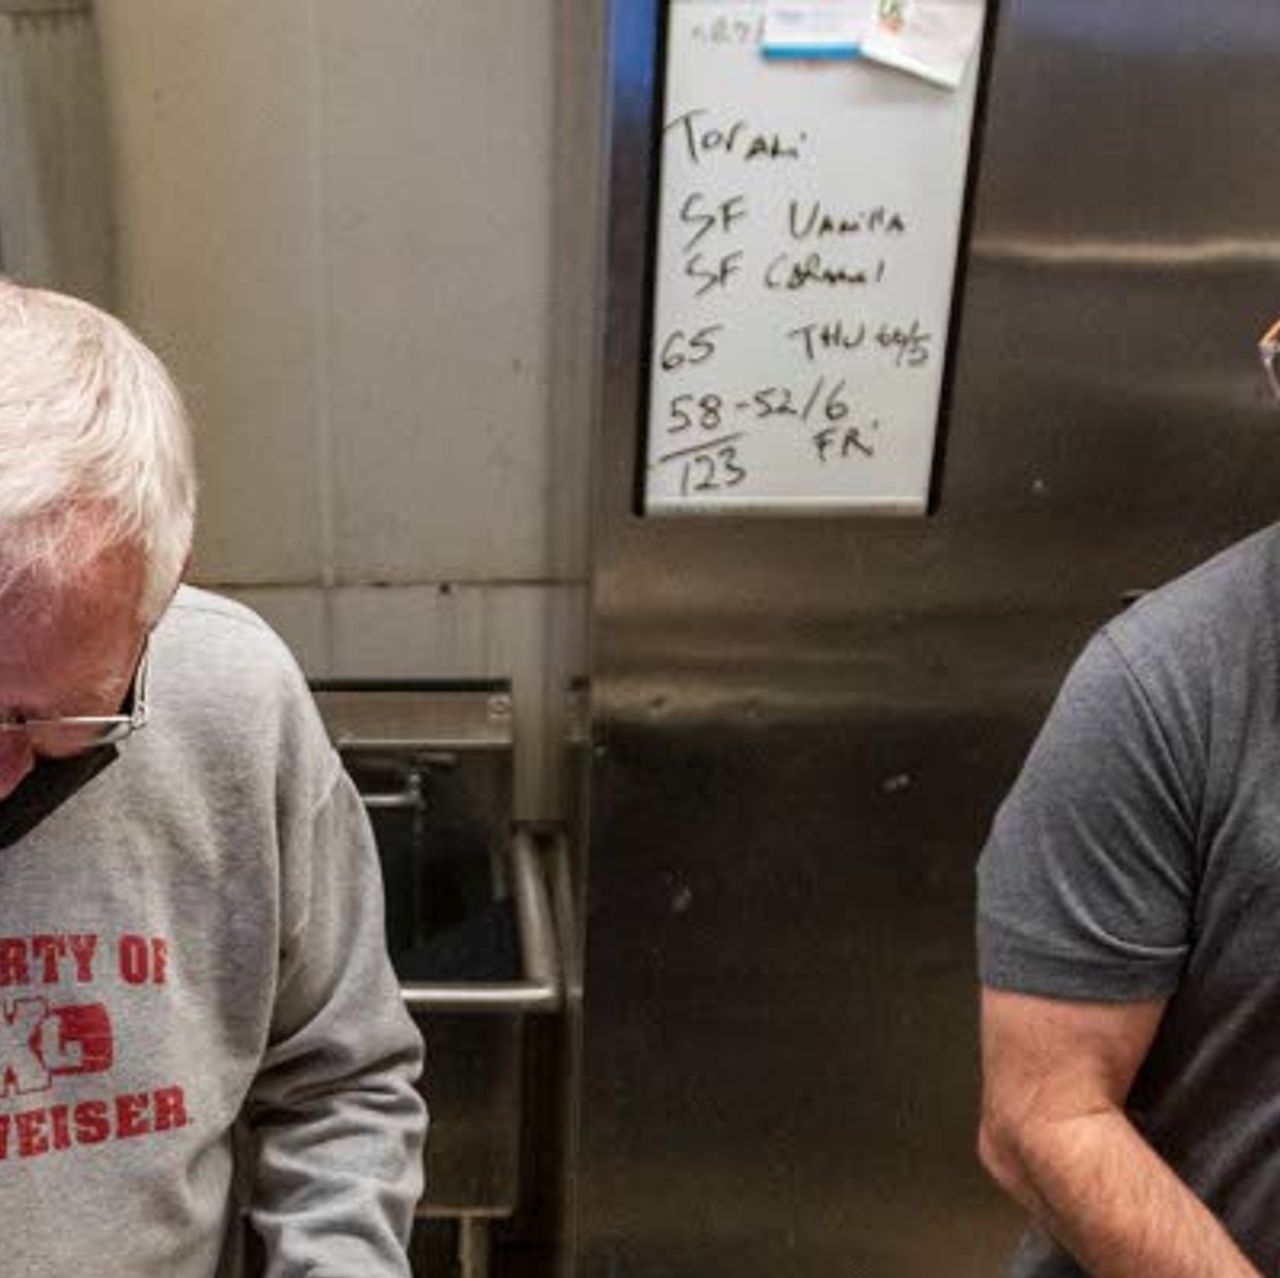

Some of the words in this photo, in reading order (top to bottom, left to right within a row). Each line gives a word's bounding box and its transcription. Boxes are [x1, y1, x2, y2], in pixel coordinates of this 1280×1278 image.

[680, 192, 746, 252] SF
[685, 250, 744, 296] SF
[660, 324, 724, 372] 65
[679, 445, 747, 497] 123
